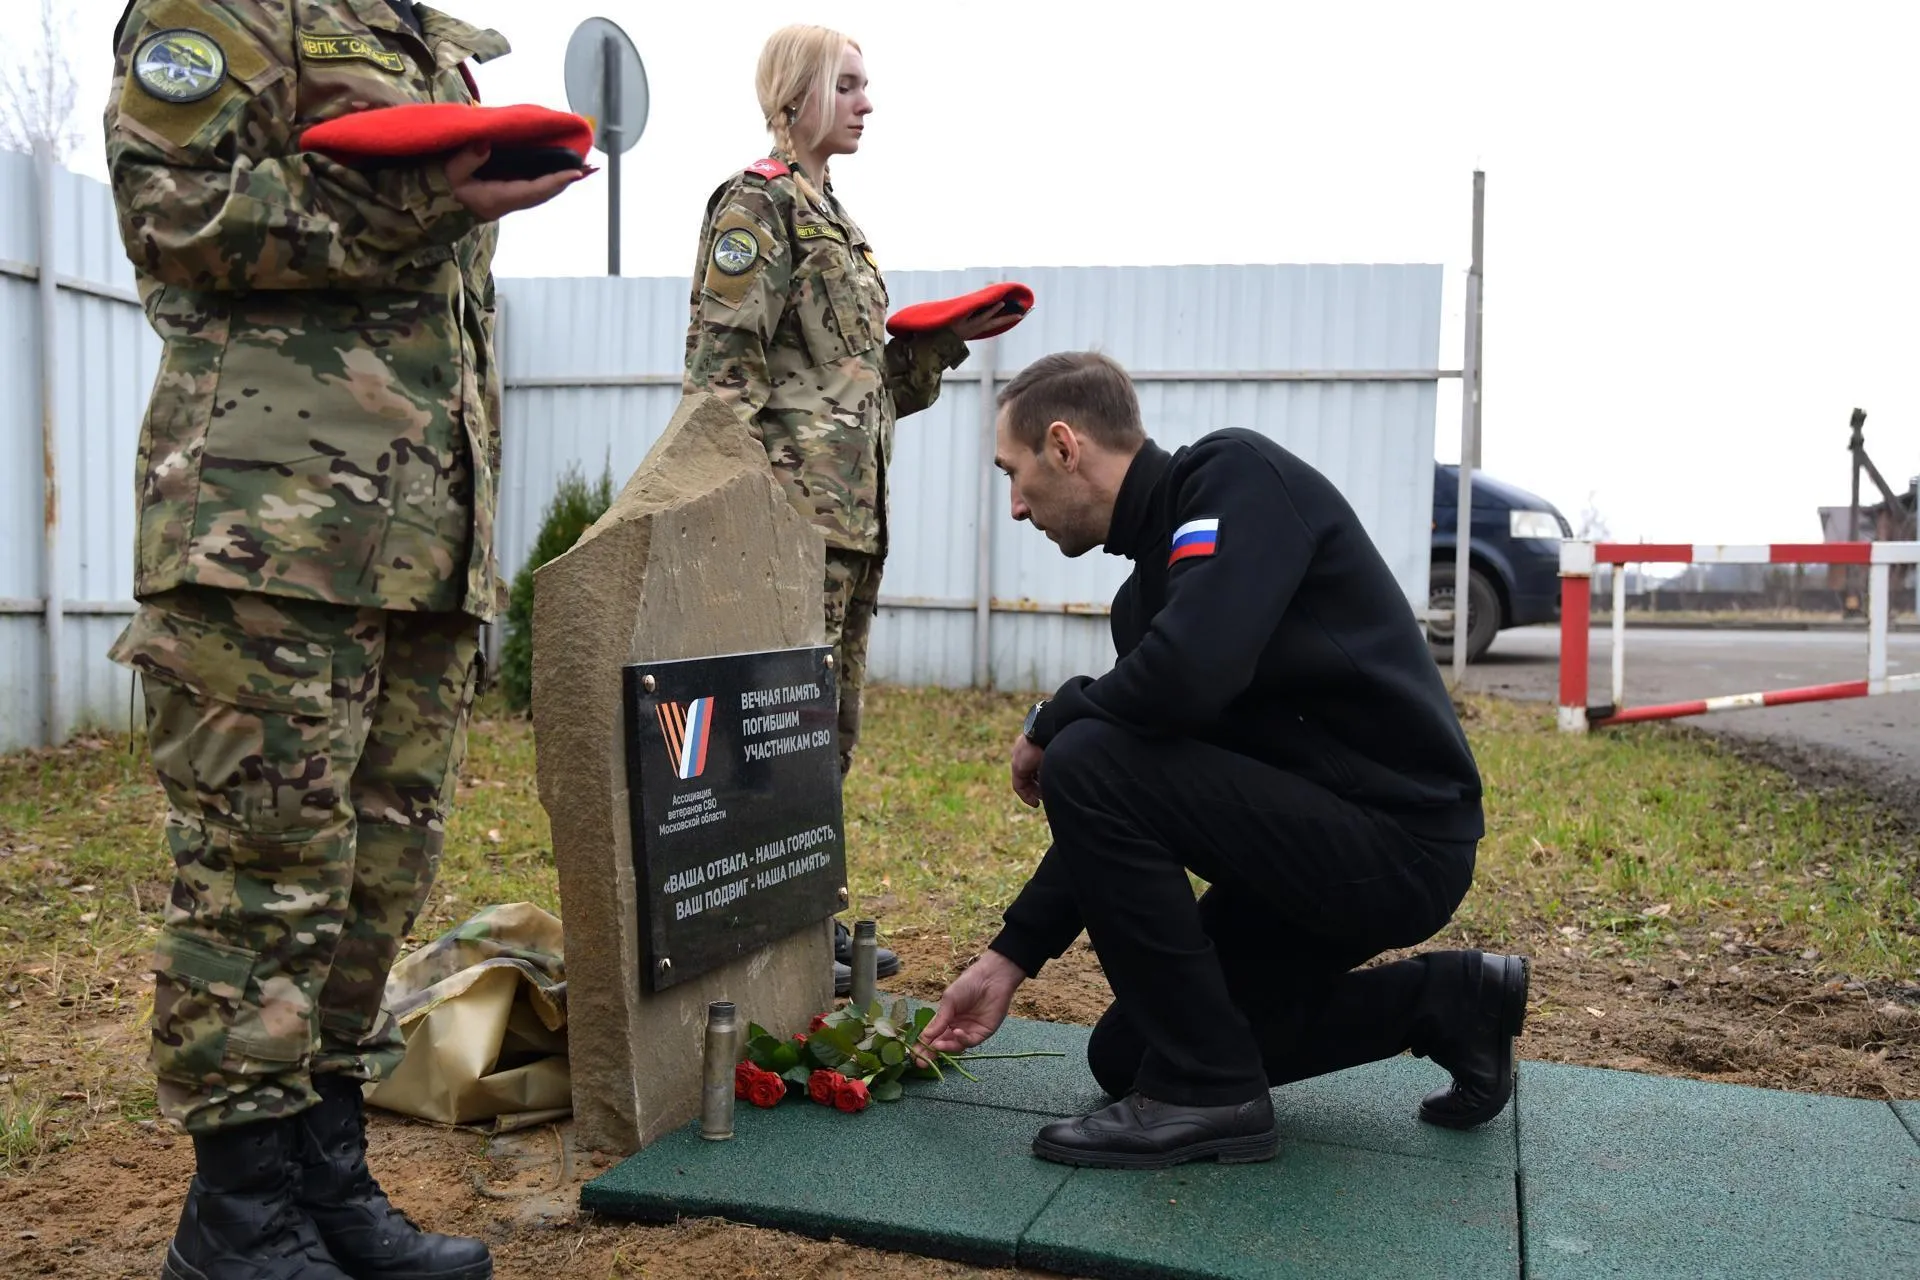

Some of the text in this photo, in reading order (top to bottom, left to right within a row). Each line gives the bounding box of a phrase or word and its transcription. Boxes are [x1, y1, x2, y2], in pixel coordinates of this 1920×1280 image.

[741, 683, 820, 710] ВЕЧНАЯ ПАМЯТЬ
[742, 710, 800, 736] ПОГИБШИМ
[744, 729, 831, 762] УЧАСТНИКАМ СВО
[667, 797, 717, 820] ветеранов СВО
[672, 788, 712, 806] Ассоциация
[659, 809, 727, 836] Московской области
[663, 866, 705, 895] «ВАША
[706, 852, 749, 881] ОТВАГА
[755, 839, 786, 865] НАША
[786, 824, 836, 854] ГОРДОСТЬ,
[675, 894, 703, 921] ВАШ
[705, 878, 749, 910] ПОДВИГ
[757, 865, 787, 890] НАША
[788, 850, 831, 879] ПАМЯТЬ»
